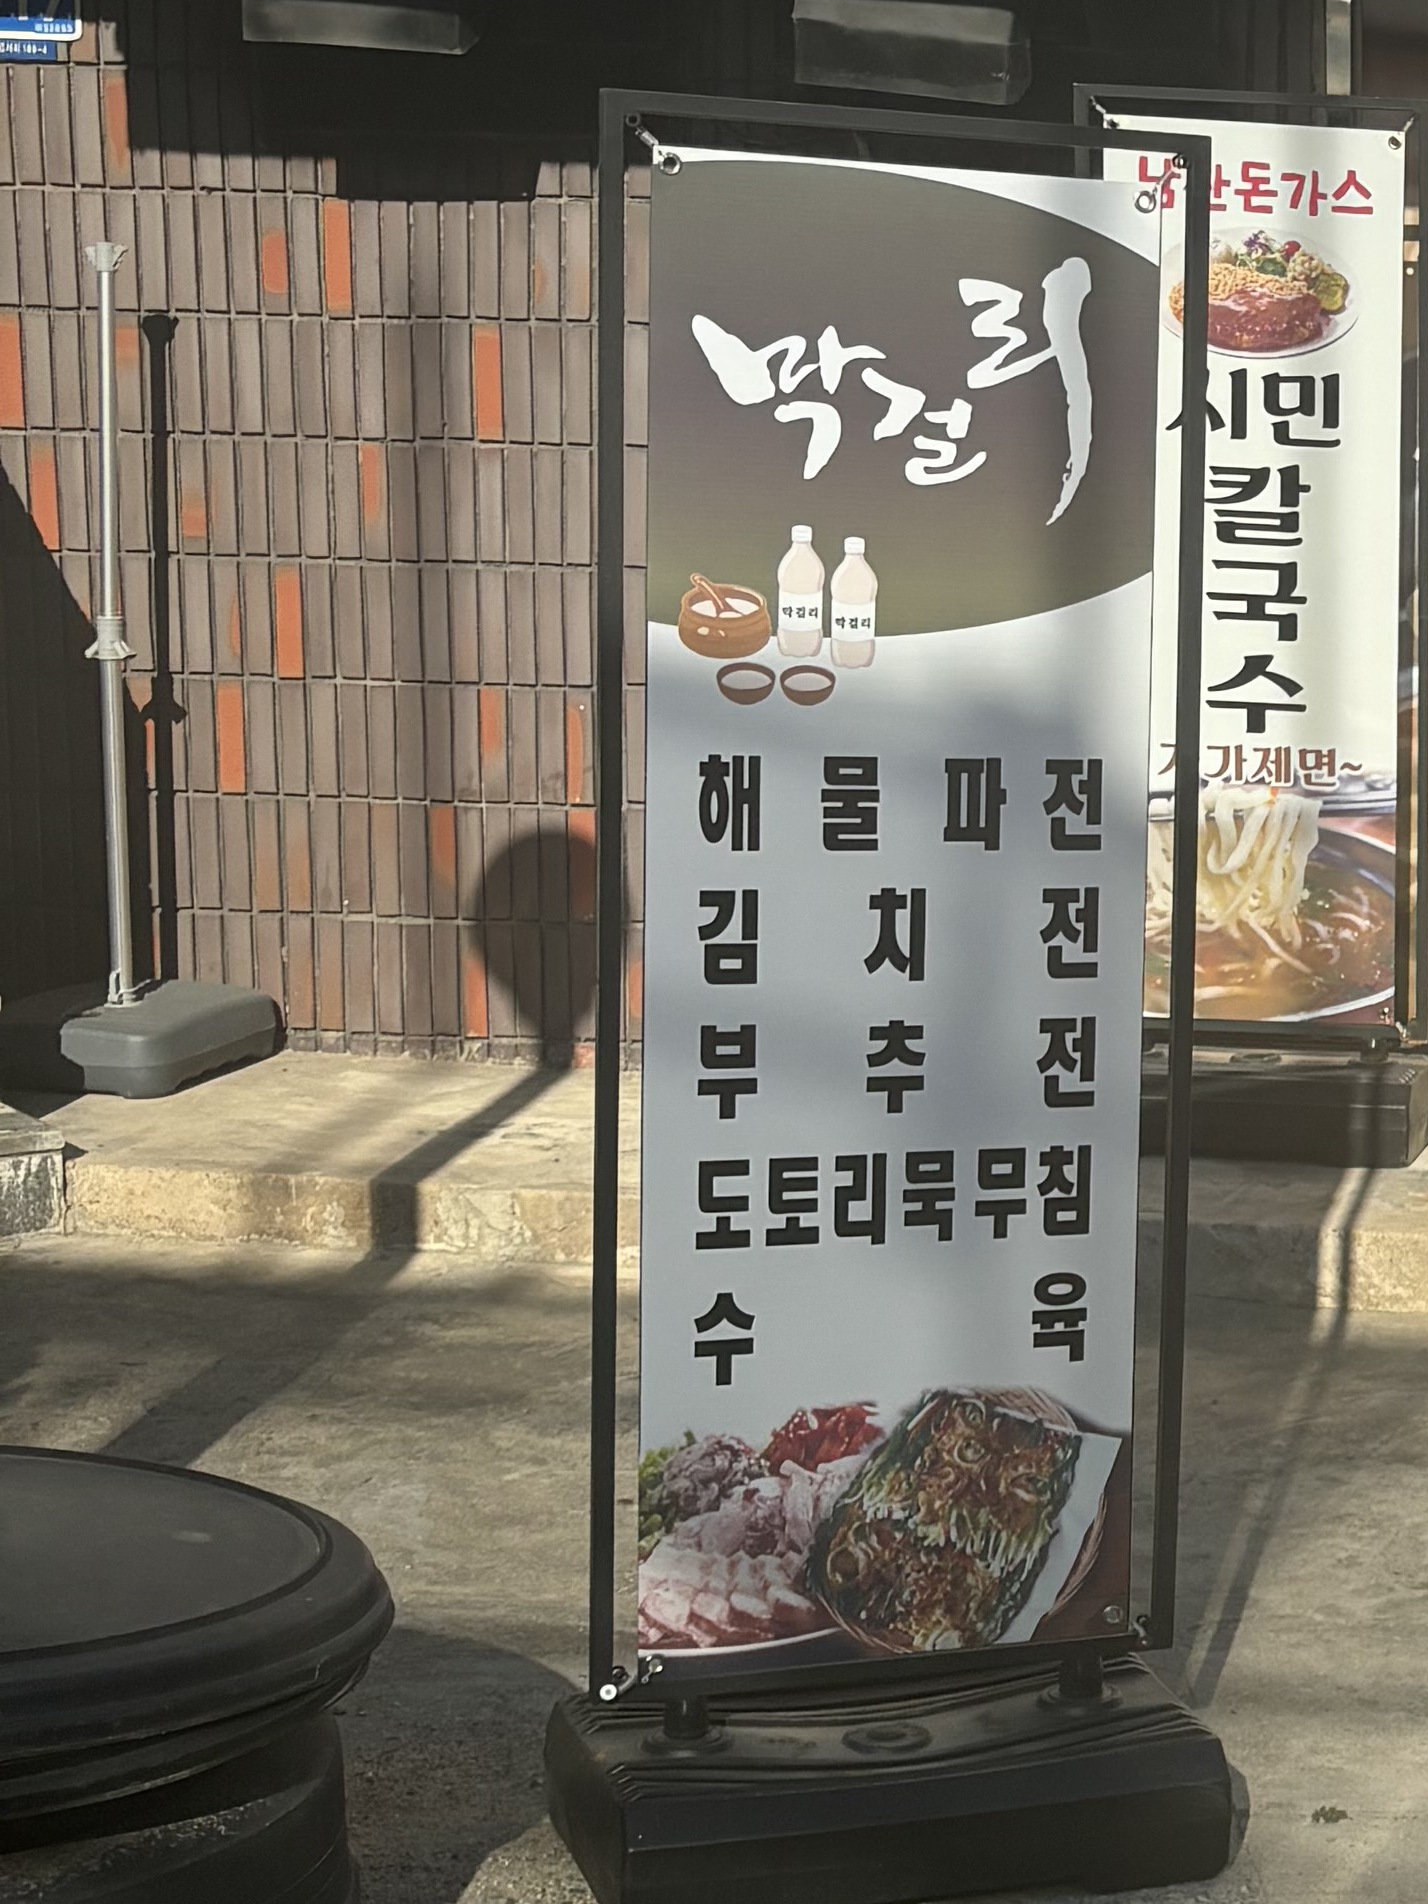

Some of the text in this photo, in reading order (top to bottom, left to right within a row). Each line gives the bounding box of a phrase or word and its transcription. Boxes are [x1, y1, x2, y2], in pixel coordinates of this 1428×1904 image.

[691, 256, 1093, 527] 막걸리
[1165, 367, 1342, 449] 시민
[1203, 464, 1312, 734] 칼국수
[694, 1144, 1093, 1250] 도토리묵무침
